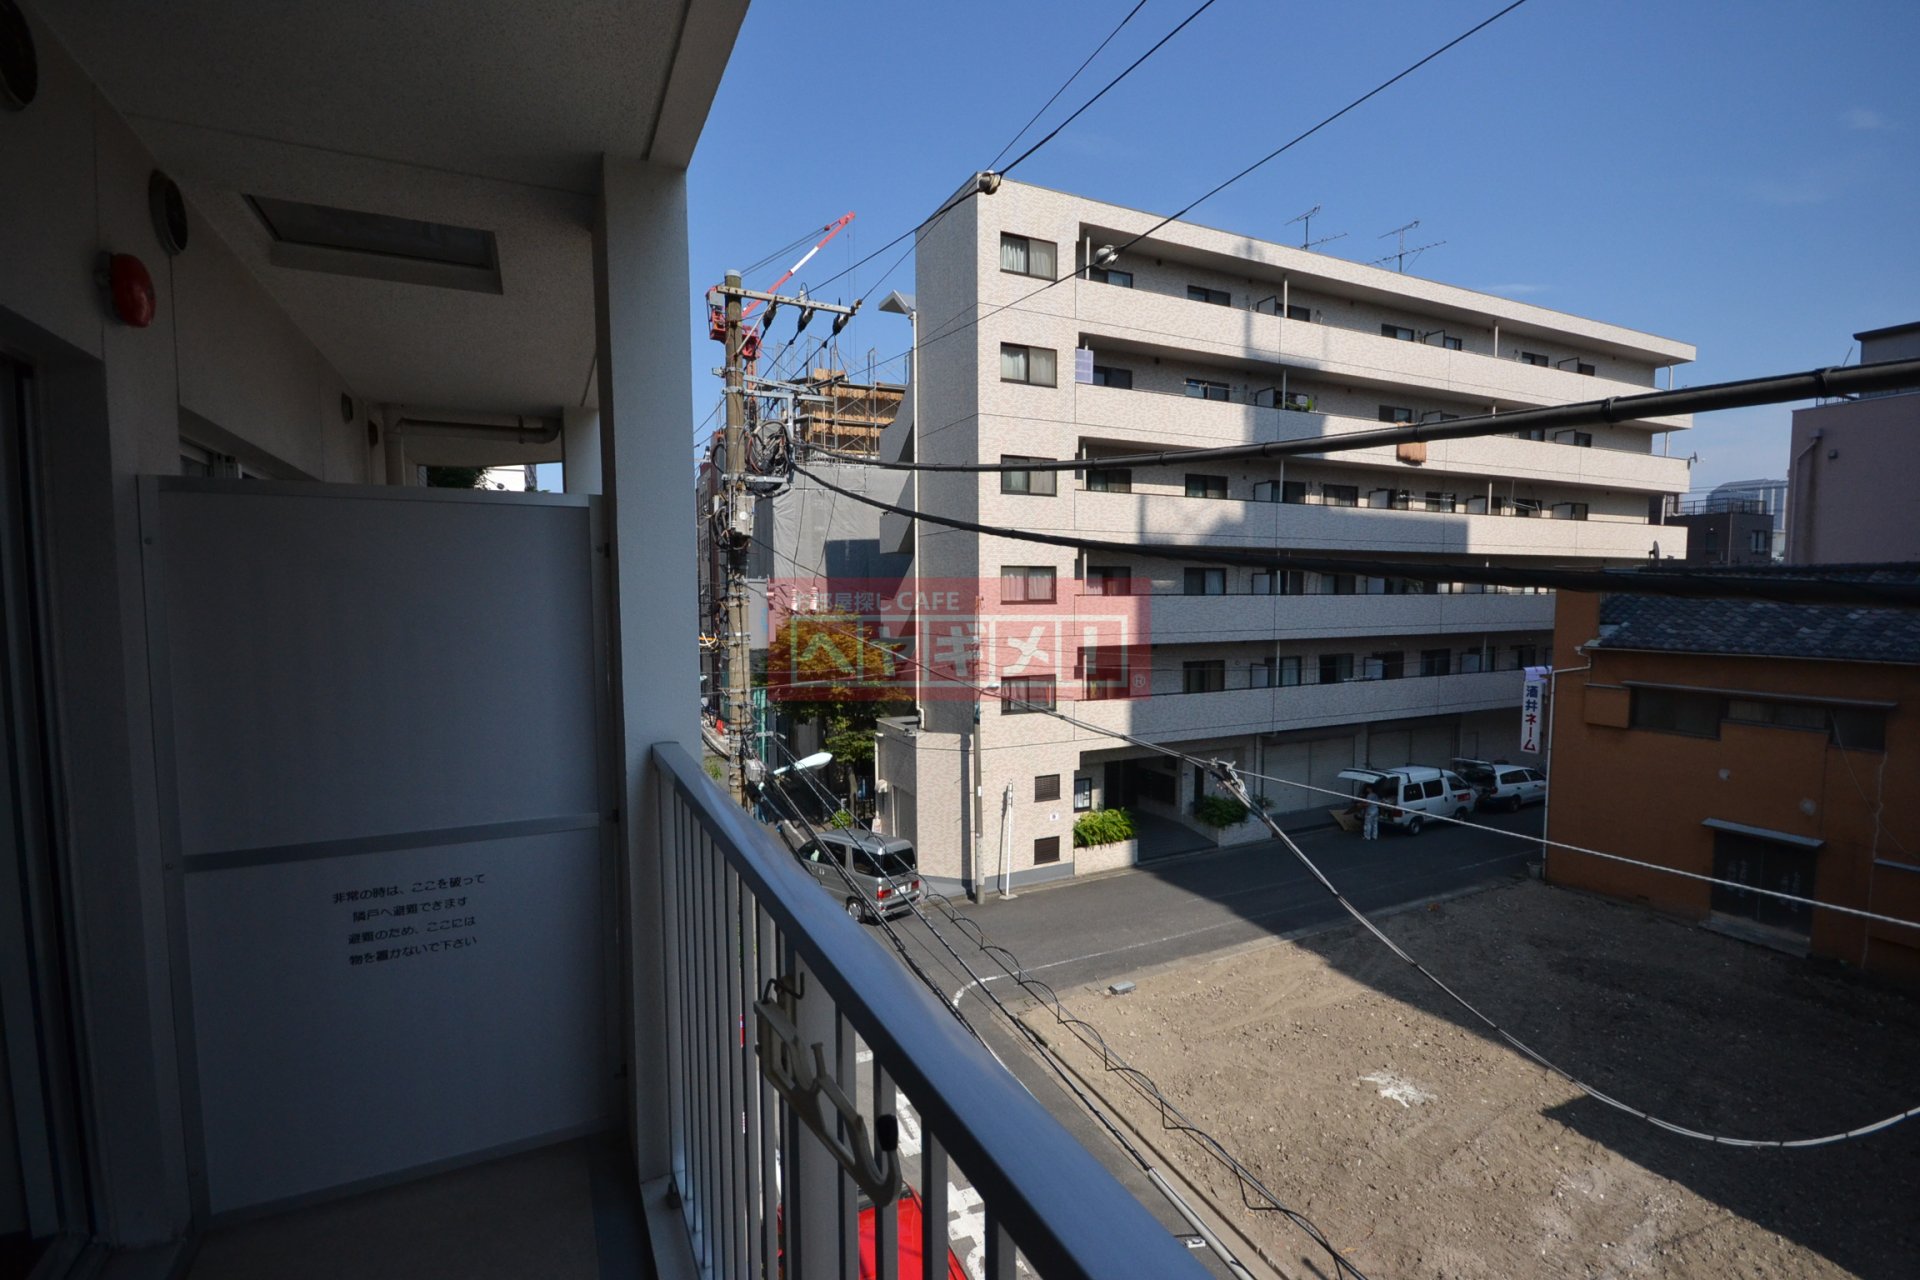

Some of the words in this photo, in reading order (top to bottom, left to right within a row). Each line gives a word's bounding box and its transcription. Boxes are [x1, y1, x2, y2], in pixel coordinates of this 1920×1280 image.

[1523, 685, 1538, 751] 酒井ネーム
[333, 873, 485, 904] 非常の時は、ここを破って
[352, 896, 468, 923] 隣戸へ避難できます
[348, 916, 476, 945] 避難のため、ここには
[349, 936, 478, 966] 物を置かないで下さい
